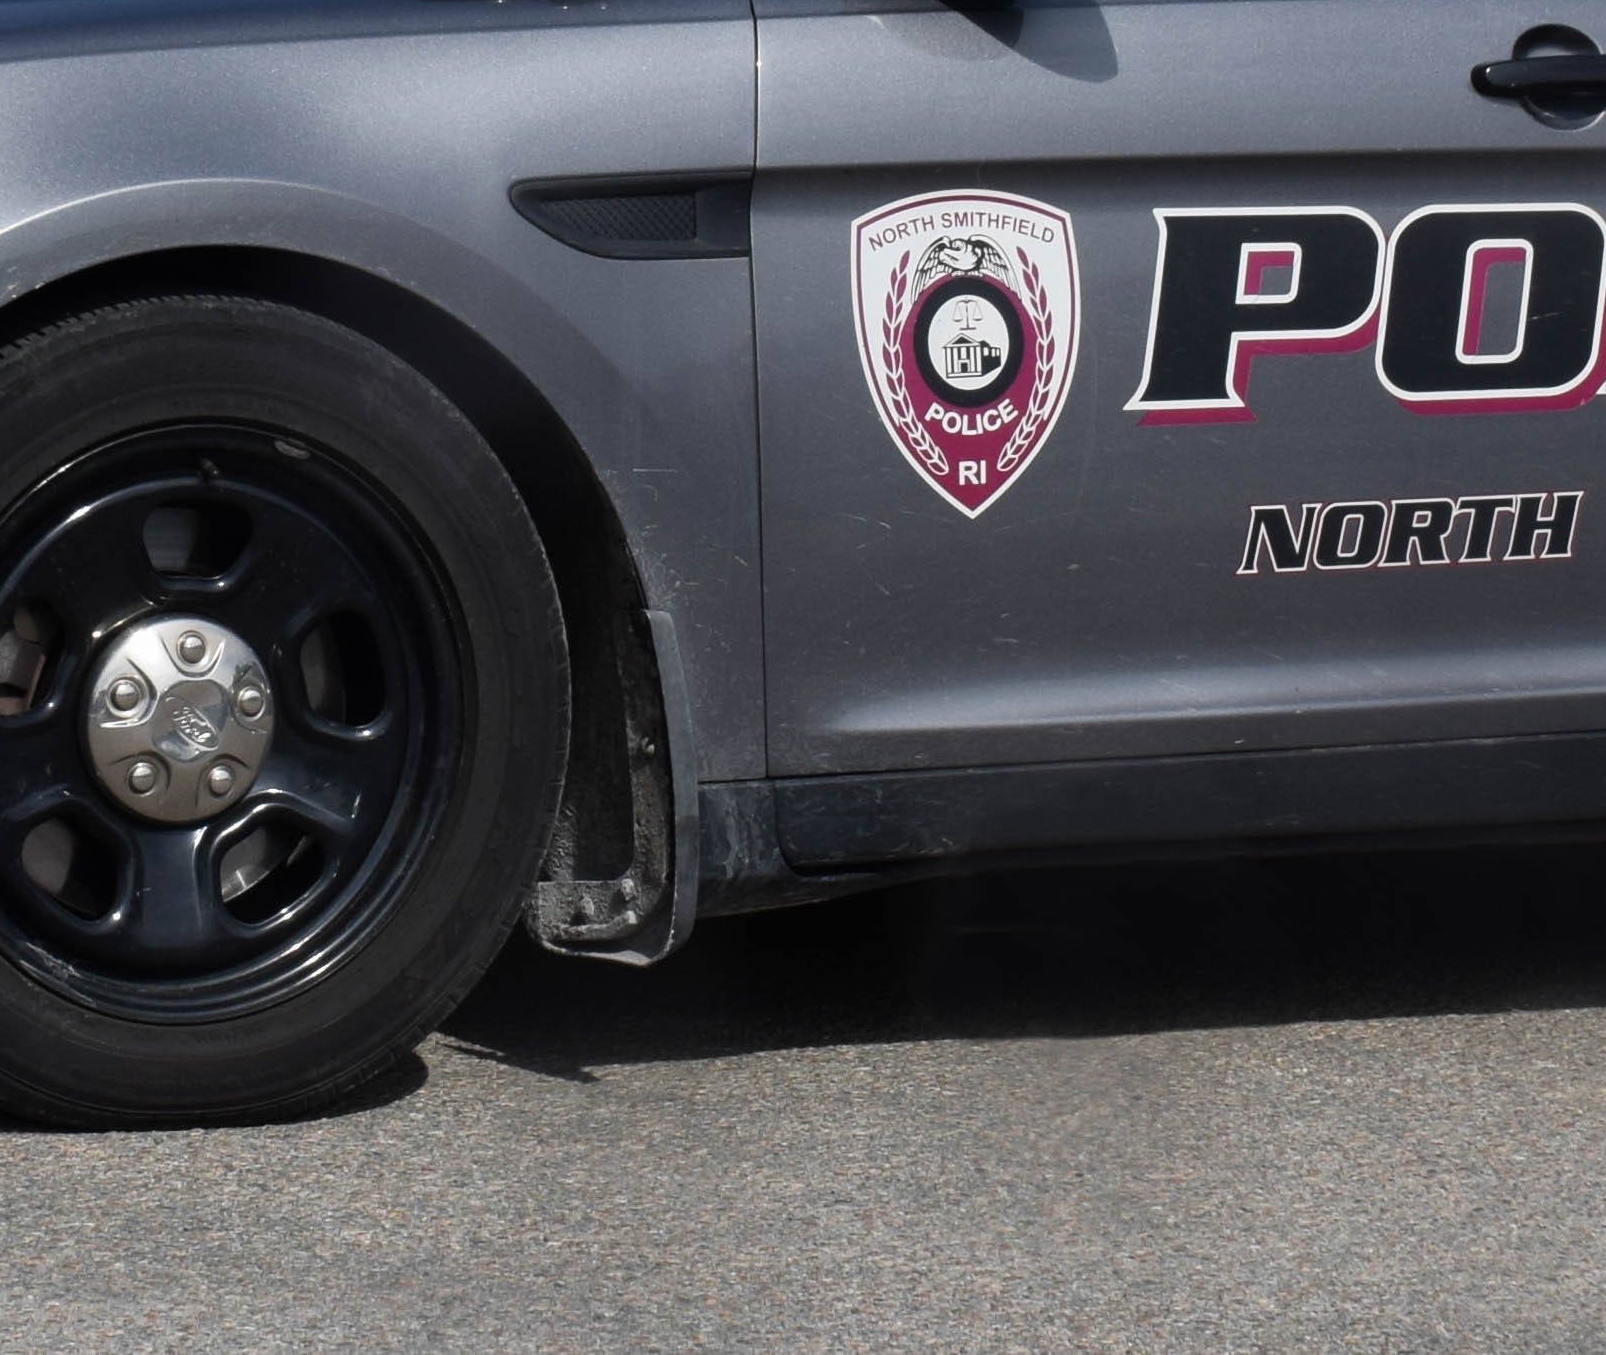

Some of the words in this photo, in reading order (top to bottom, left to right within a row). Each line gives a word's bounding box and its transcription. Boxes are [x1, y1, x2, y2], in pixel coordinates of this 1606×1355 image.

[868, 214, 936, 251] NORTH
[941, 212, 1055, 243] SMITHFIELD
[924, 398, 1019, 436] POLICE
[958, 460, 987, 486] RI
[1235, 491, 1585, 574] NORTH
